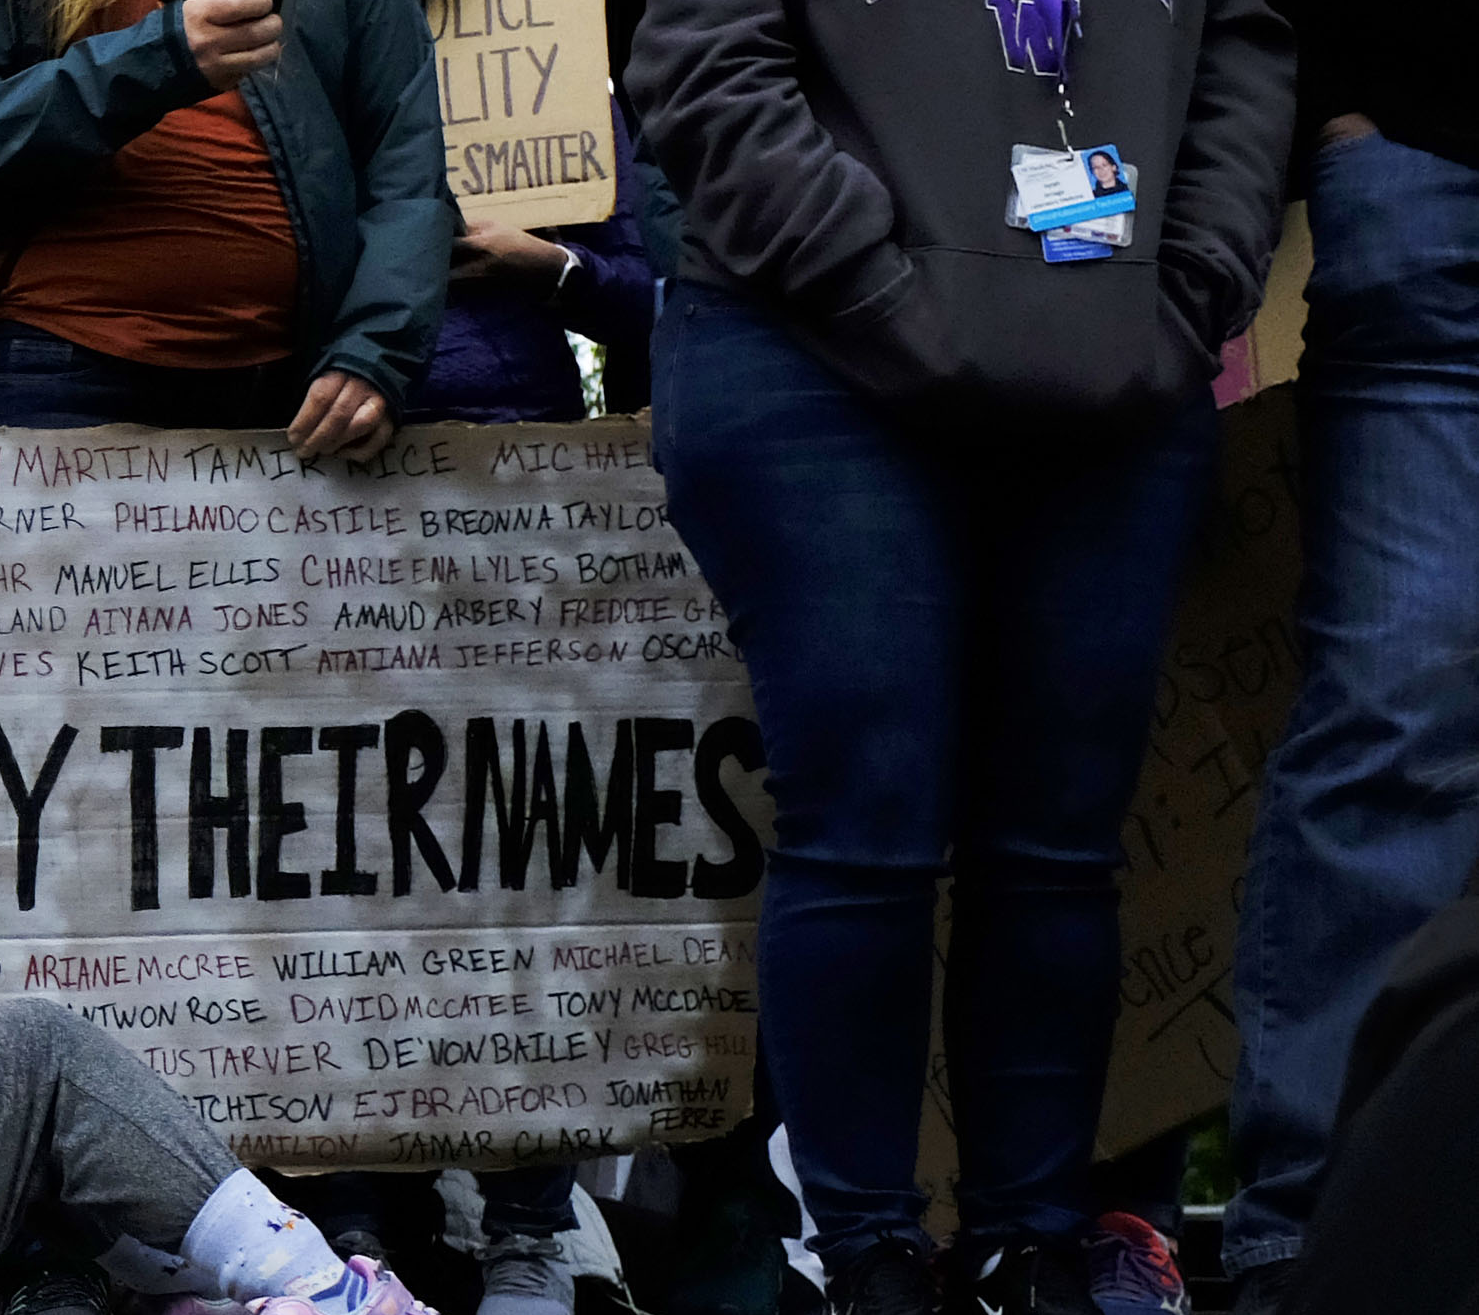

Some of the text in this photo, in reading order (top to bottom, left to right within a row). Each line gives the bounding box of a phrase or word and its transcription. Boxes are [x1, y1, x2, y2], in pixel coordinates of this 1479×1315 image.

[442, 43, 558, 126] LITY
[14, 446, 169, 488] MARTIN
[116, 502, 258, 534] PHILANDO
[268, 506, 407, 537] CASTILE
[422, 503, 551, 537] BREONNA
[55, 560, 177, 597] MANUEL
[189, 558, 280, 588] ELLIS
[302, 554, 461, 589] CHARLEENA
[472, 555, 559, 586] LYLES
[578, 552, 687, 584] BOTHAM
[85, 606, 192, 638] AIYANA
[214, 601, 309, 633] JONES
[434, 596, 542, 631] ARBERY
[560, 596, 675, 627] FREDDIE
[77, 647, 185, 686] KEITH
[199, 643, 310, 678] SCOTT
[317, 644, 441, 674] ATATIANA
[456, 639, 629, 670] JEFFERSON
[642, 632, 730, 662] OSCAR
[100, 709, 456, 912] THEIR
[457, 716, 766, 900] NAMES
[24, 954, 127, 992] ARIANE
[273, 951, 406, 982] WILLIAM
[423, 946, 534, 975] GREEN
[553, 943, 672, 972] MICHAEL
[187, 996, 268, 1024] ROSE
[291, 994, 398, 1025] DAVID
[405, 994, 534, 1020] MCCATEE
[547, 988, 622, 1018] TONY
[200, 1041, 341, 1079] TARVER
[363, 1034, 486, 1070] DE'VON
[491, 1029, 612, 1065] BAILEY
[624, 1032, 700, 1059] GREG
[183, 1075, 730, 1123] TCHISON EJ BRADFORD JONATHAN
[389, 1130, 497, 1163] JAMAR
[514, 1126, 614, 1159] CLARK
